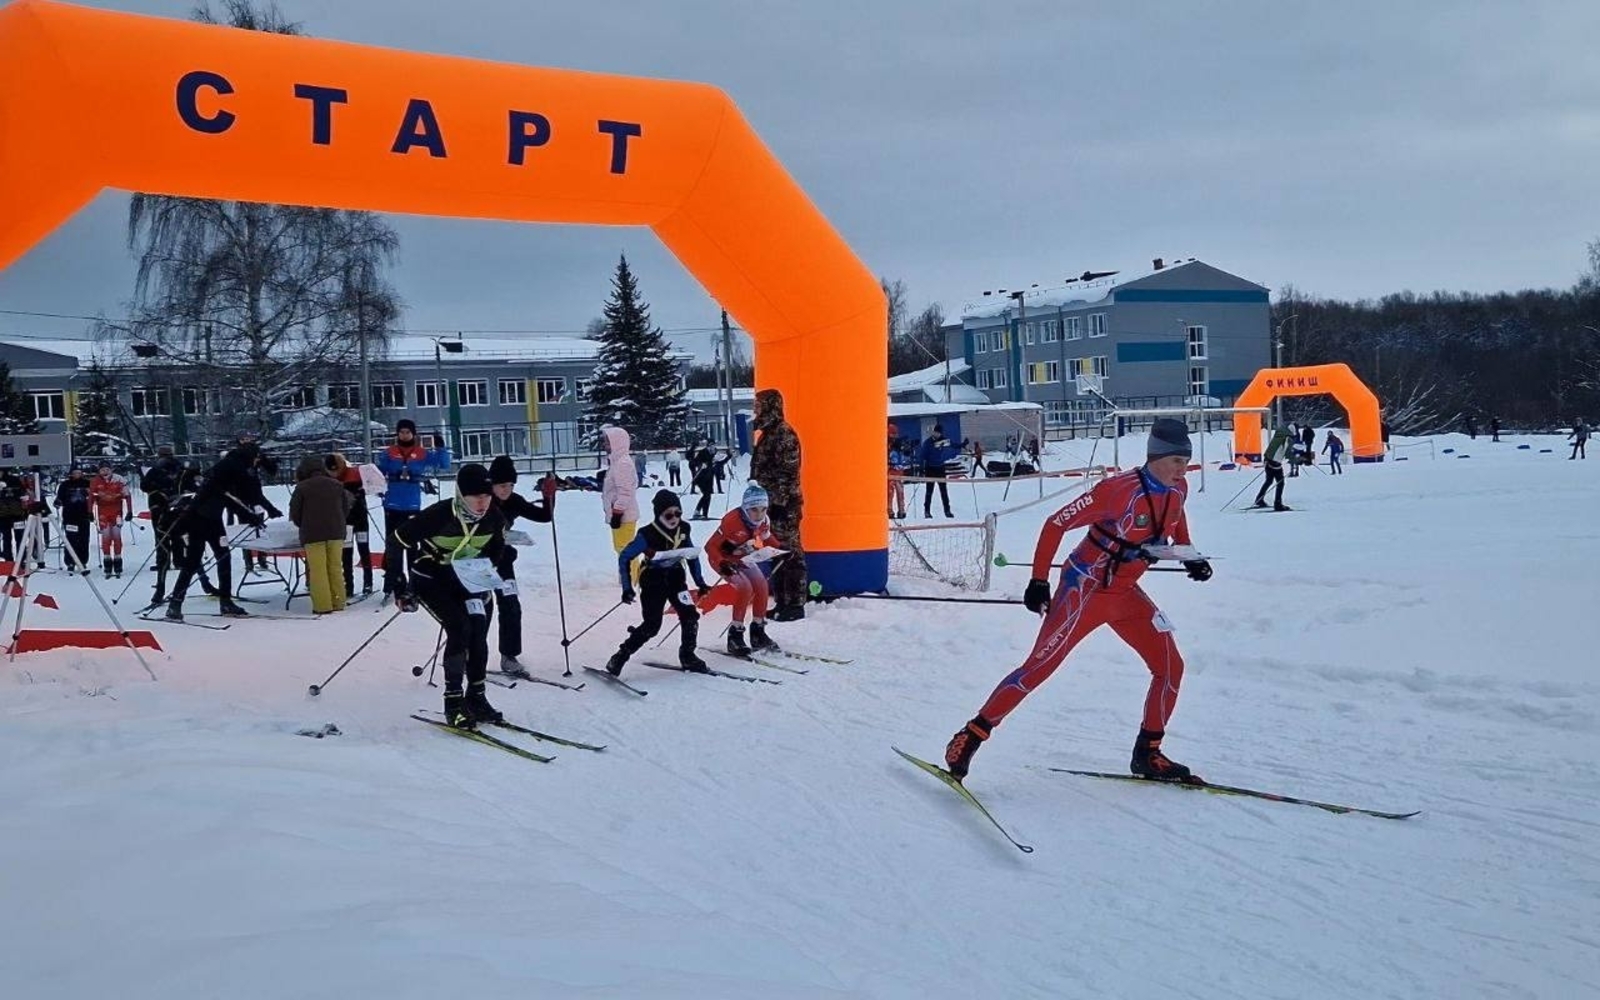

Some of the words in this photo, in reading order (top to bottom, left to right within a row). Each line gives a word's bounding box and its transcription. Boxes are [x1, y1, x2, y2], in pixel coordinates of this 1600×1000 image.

[175, 70, 642, 175] СТАРТ
[1265, 376, 1318, 388] ФИНИШ
[1052, 495, 1094, 527] RUSSIA
